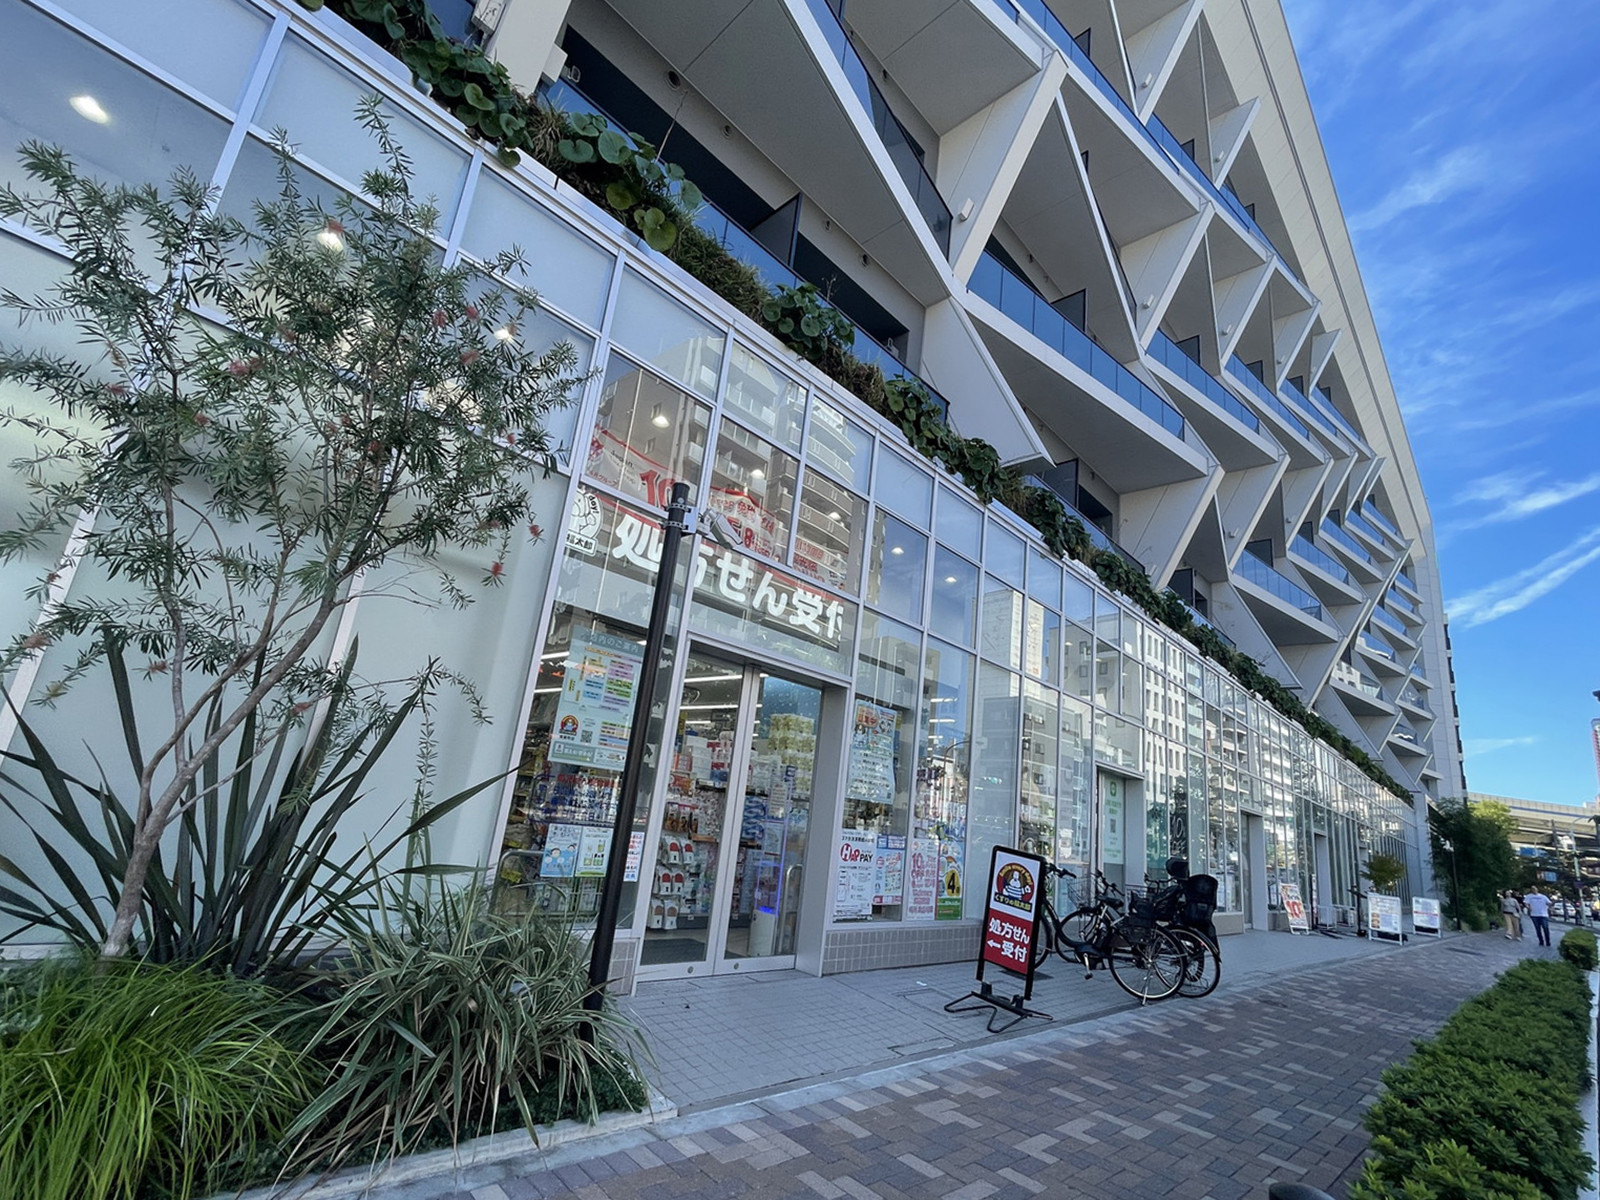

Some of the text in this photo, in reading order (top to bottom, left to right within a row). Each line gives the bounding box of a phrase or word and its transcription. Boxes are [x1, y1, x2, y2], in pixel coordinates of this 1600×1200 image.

[612, 513, 844, 642] 処せん受
[989, 917, 1030, 945] 処方せん
[1001, 940, 1028, 963] 受付
